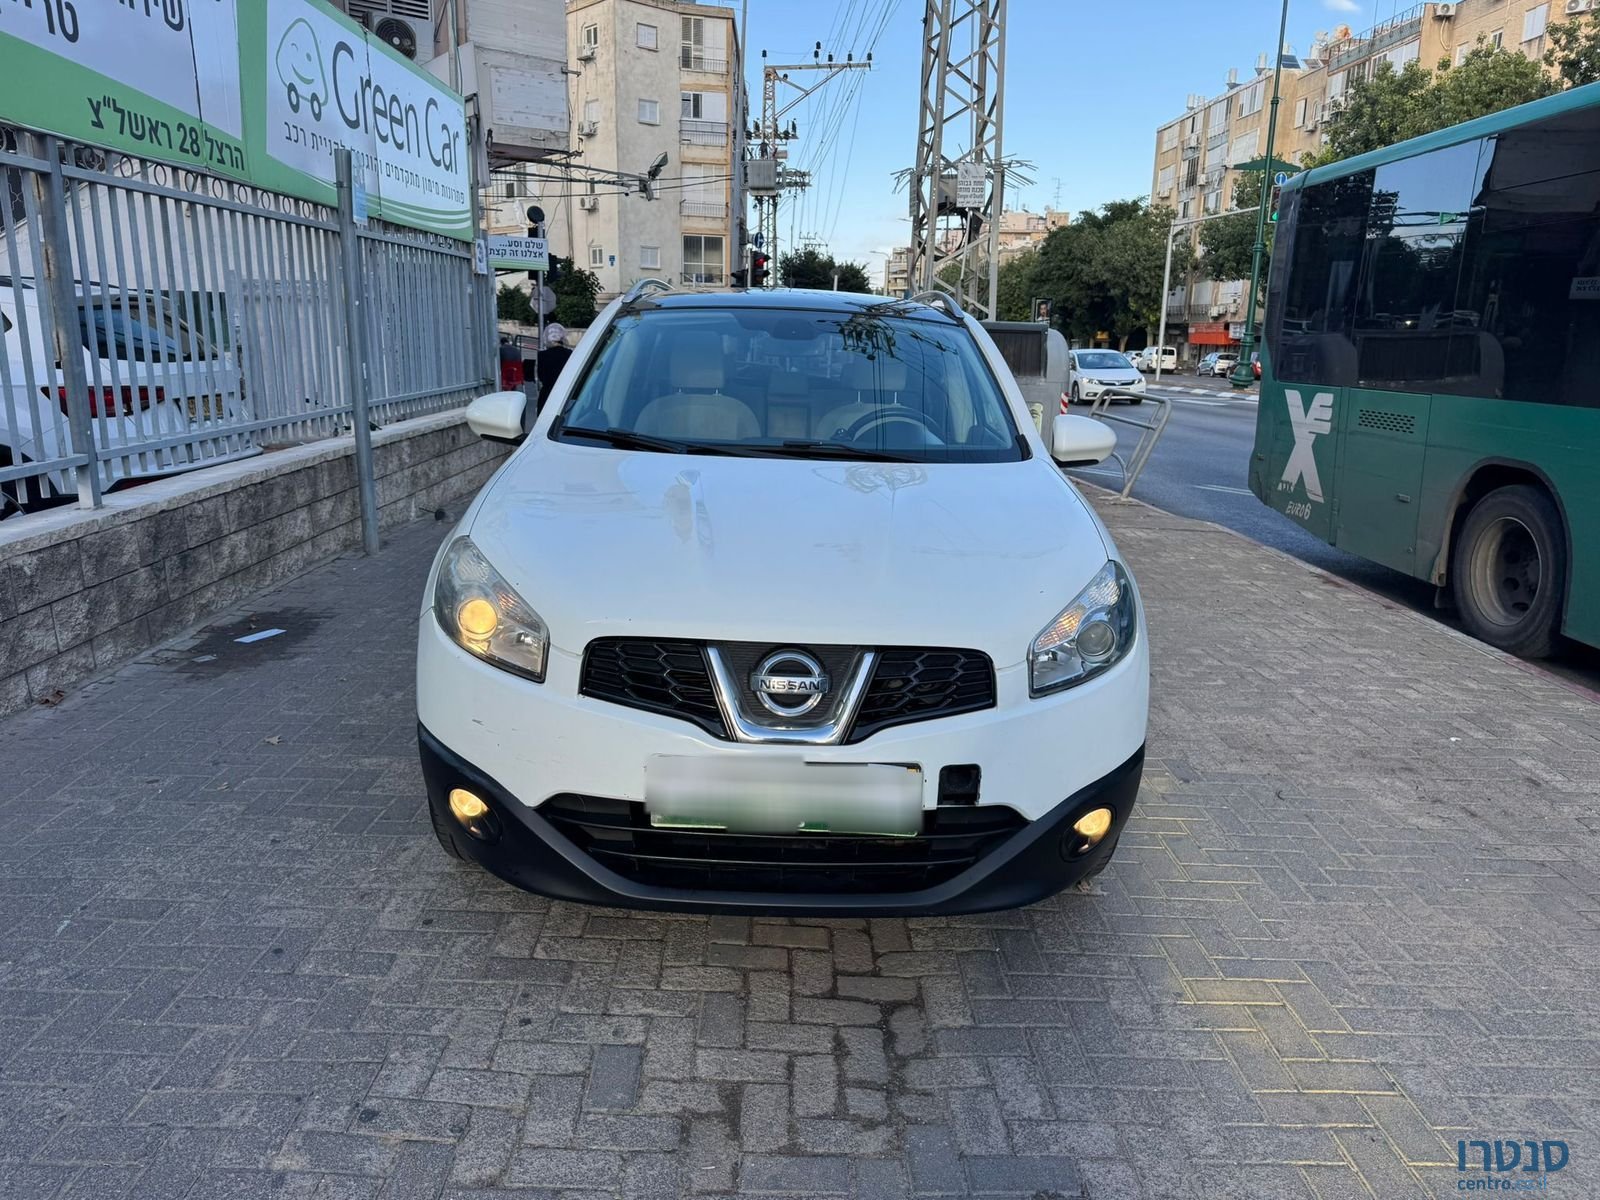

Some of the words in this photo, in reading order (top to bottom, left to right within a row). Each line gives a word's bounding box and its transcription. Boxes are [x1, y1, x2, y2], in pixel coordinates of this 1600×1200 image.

[332, 41, 420, 158] Green
[425, 97, 460, 175] Car
[176, 122, 201, 157] 28
[284, 121, 307, 147] רכב
[204, 128, 245, 171] הרצל
[385, 162, 421, 189] מתקדמים
[422, 176, 440, 195] מימון
[441, 184, 465, 204] פתרונות
[489, 247, 507, 258] קצת
[509, 249, 519, 257] זה
[521, 249, 544, 258] אצלנו
[525, 240, 544, 249] שלם
[759, 679, 820, 691] NISSAN
